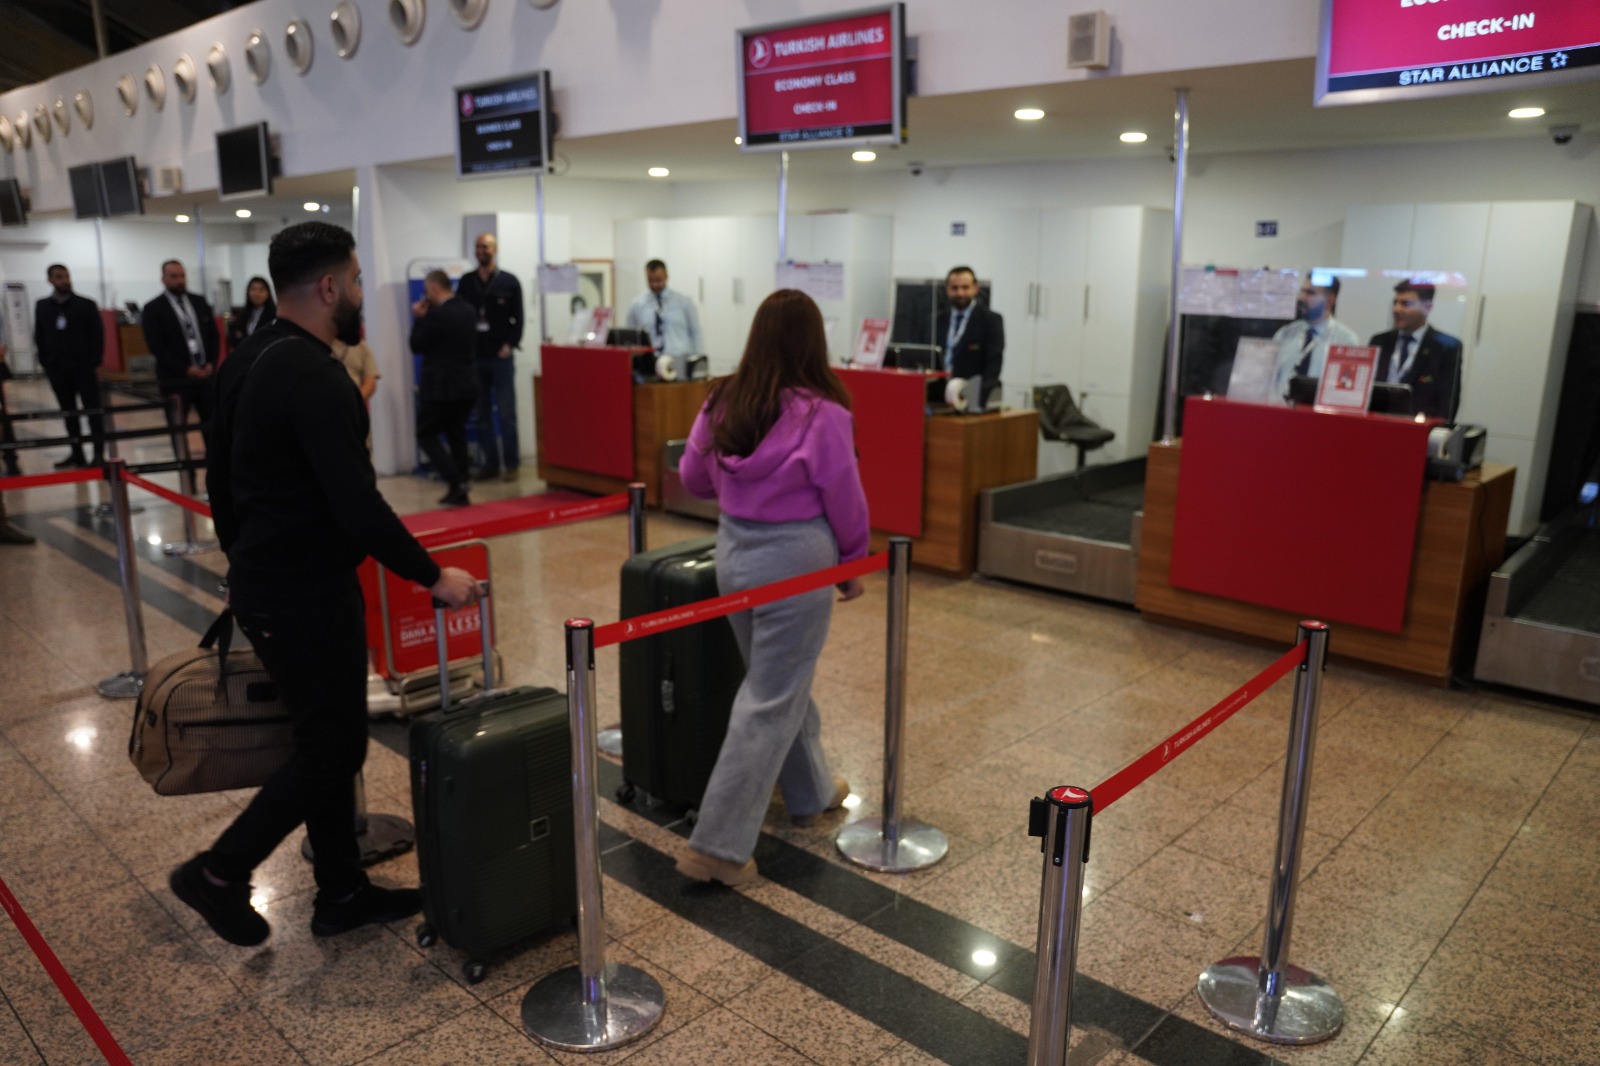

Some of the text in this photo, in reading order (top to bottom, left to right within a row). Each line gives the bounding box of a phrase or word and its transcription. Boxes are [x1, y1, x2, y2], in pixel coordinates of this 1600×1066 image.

[1437, 12, 1535, 41] CHECK-IN
[774, 27, 884, 57] TURKISH AIRLINES
[774, 71, 857, 92] ECONOMY CLASS
[1399, 56, 1544, 86] STAR ALLIANCE
[793, 101, 838, 115] CHECK-IN
